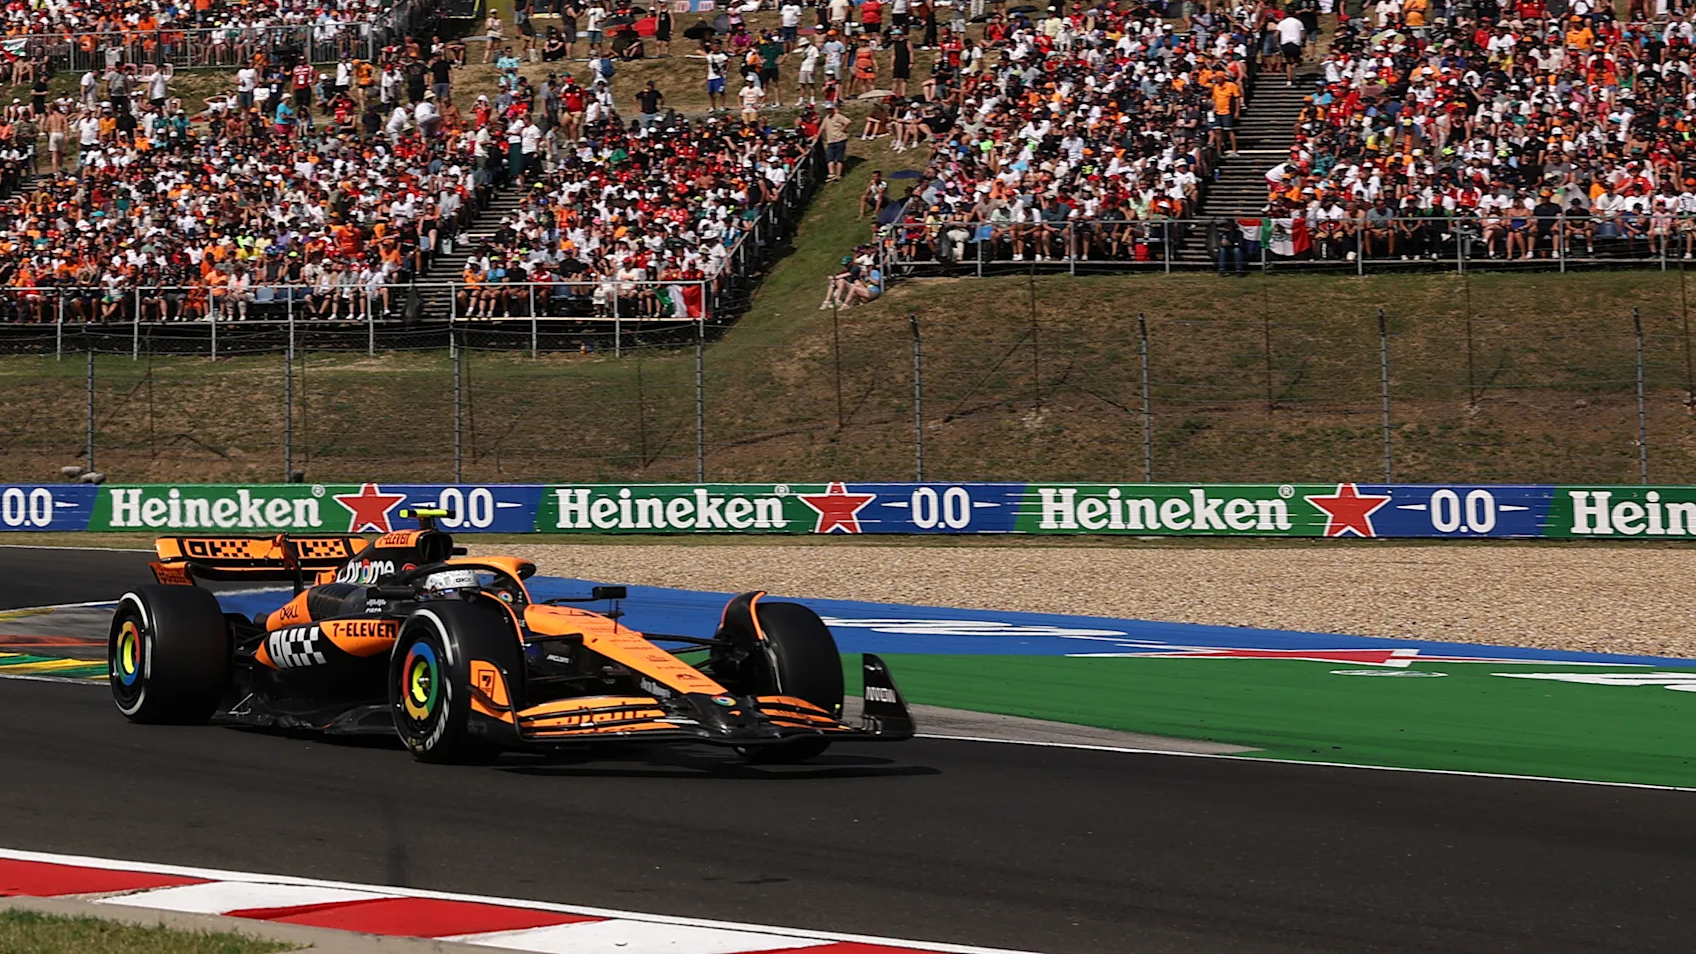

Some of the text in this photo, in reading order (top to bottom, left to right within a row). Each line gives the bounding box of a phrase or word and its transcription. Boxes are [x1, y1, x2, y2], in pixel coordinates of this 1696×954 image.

[2, 488, 53, 527] 0.0
[110, 488, 494, 528] Heineken 0.0
[555, 487, 971, 529] Heineken 0.0
[1038, 488, 1496, 533] Heineken 0.0
[1568, 491, 1696, 535] Hein
